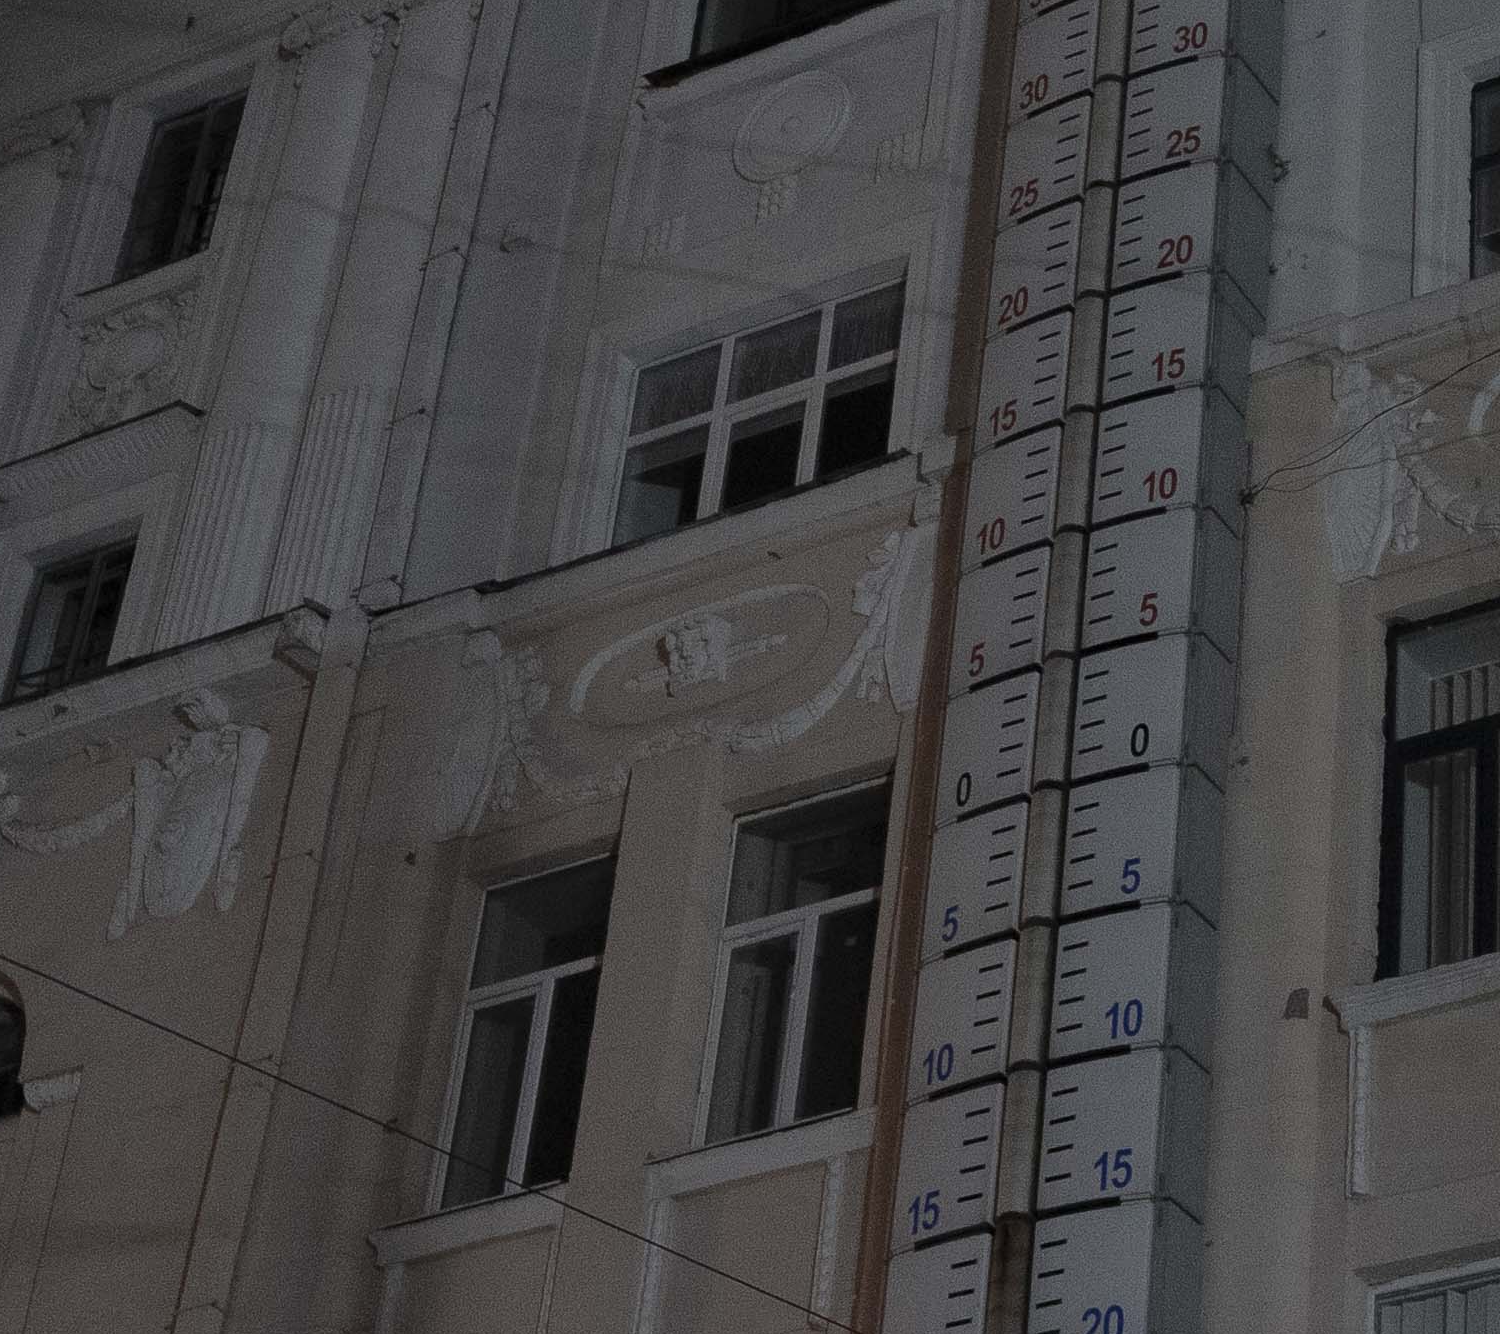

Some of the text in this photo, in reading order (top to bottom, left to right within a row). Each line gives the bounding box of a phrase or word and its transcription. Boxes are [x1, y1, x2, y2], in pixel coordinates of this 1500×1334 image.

[1173, 22, 1208, 53] 30
[1019, 74, 1048, 110] 30
[1166, 126, 1201, 158] 25
[1009, 179, 1039, 216] 25
[1157, 235, 1193, 268] 20
[999, 288, 1029, 324] 20
[1151, 349, 1186, 381] 15
[990, 399, 1017, 436] 15
[1143, 468, 1178, 503] 10
[977, 518, 1005, 554] 10
[1140, 592, 1158, 626] 5
[969, 642, 984, 677] 5
[1131, 723, 1149, 757] 0
[956, 772, 972, 807] 0
[1121, 858, 1141, 894] 5
[942, 906, 959, 943] 5
[1105, 999, 1143, 1040] 10
[923, 1042, 954, 1086] 10
[1094, 1148, 1133, 1190] 15
[908, 1190, 941, 1234] 15
